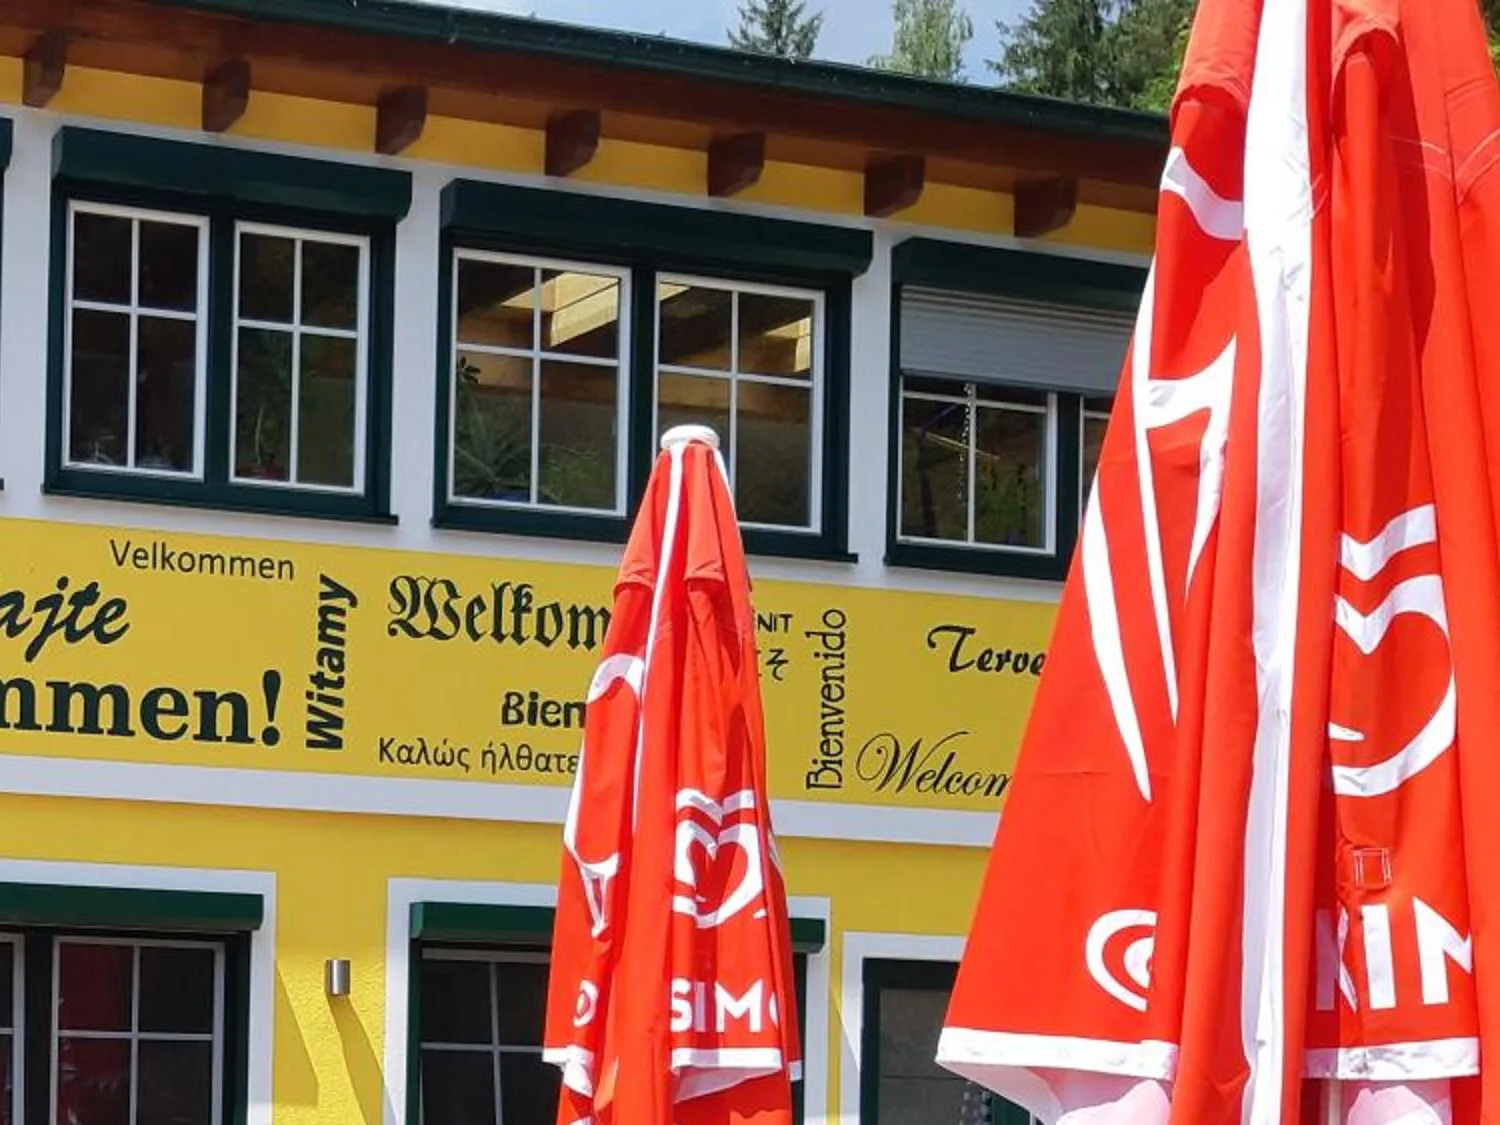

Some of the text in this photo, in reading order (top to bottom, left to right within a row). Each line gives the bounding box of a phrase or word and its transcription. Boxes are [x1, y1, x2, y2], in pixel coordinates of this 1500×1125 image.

[111, 539, 294, 581] Velkommen
[754, 611, 793, 633] NIT
[306, 573, 358, 750] Witamy
[927, 624, 1047, 676] Terve
[501, 690, 587, 729] Bien
[805, 608, 847, 790] Bienvenido
[379, 737, 470, 773] Καλώς
[855, 731, 1012, 796] Welcom
